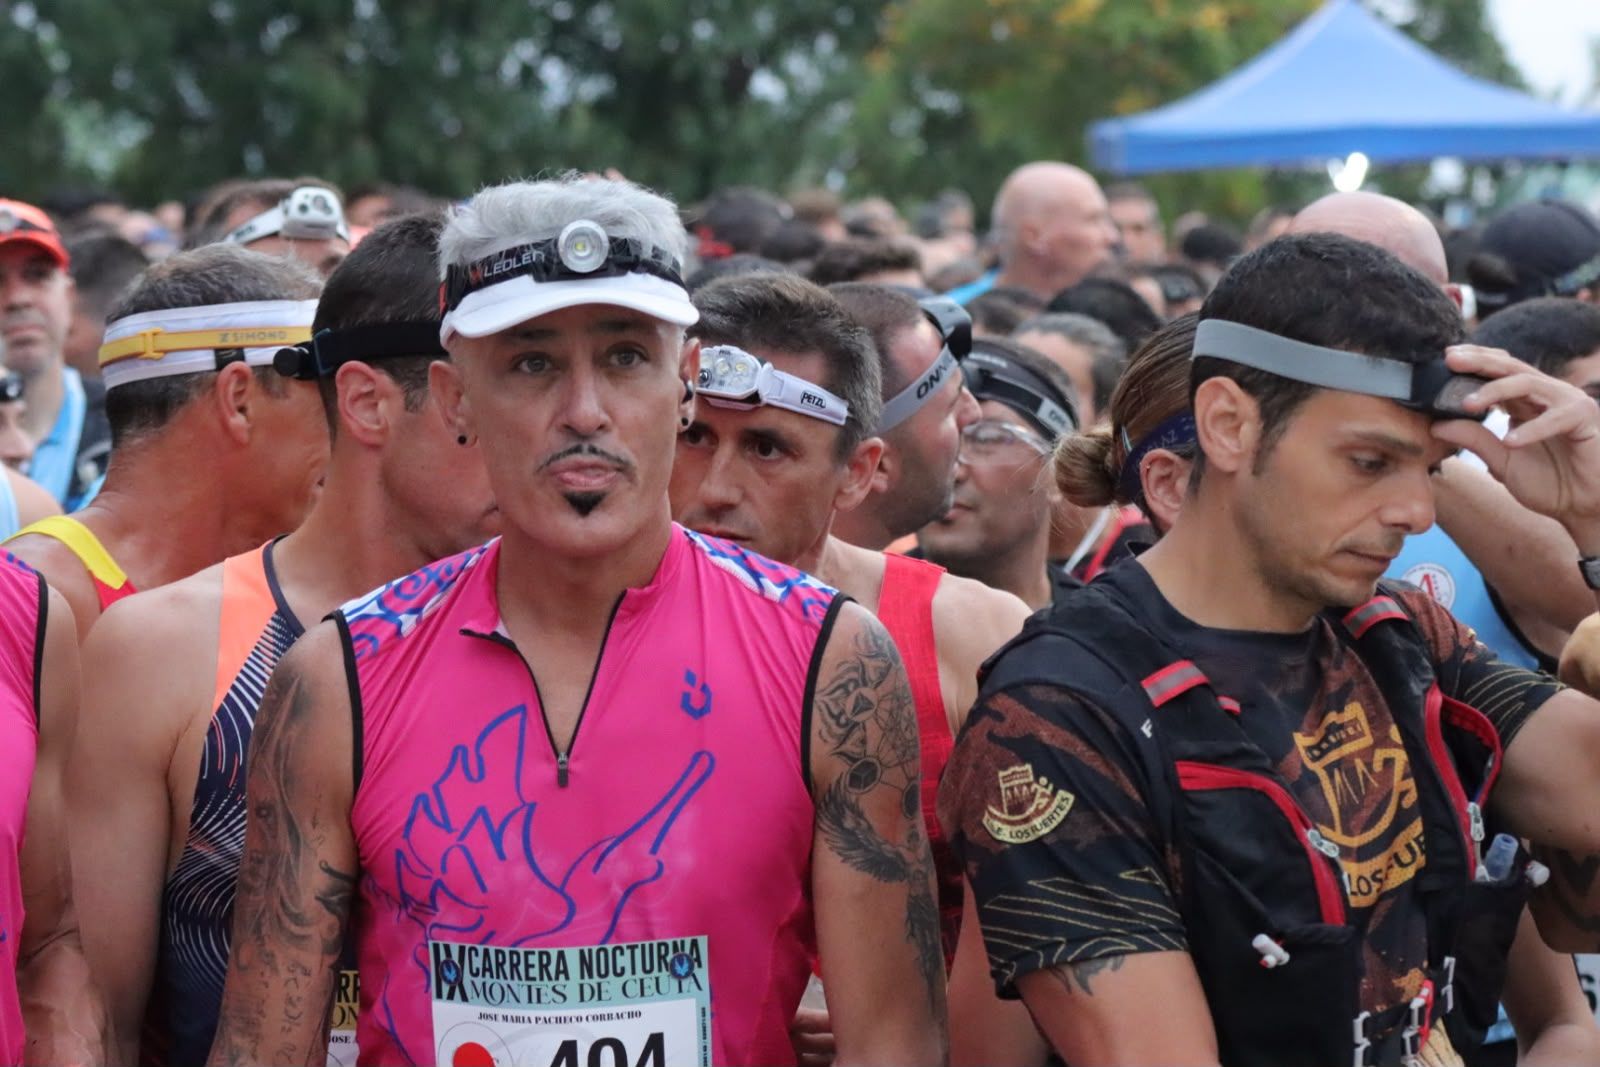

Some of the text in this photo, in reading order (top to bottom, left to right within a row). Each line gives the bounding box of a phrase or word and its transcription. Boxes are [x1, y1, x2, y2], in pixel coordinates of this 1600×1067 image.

[233, 331, 288, 342] SIMOND
[801, 391, 826, 409] PETZL
[1009, 828, 1031, 840] LOS
[432, 943, 469, 1003] IX
[468, 946, 571, 982] CARRERA
[470, 980, 568, 1006] MONTES
[578, 981, 612, 1003] DE
[478, 1010, 642, 1025] JOSE MARIA PACHECO CORBACHO
